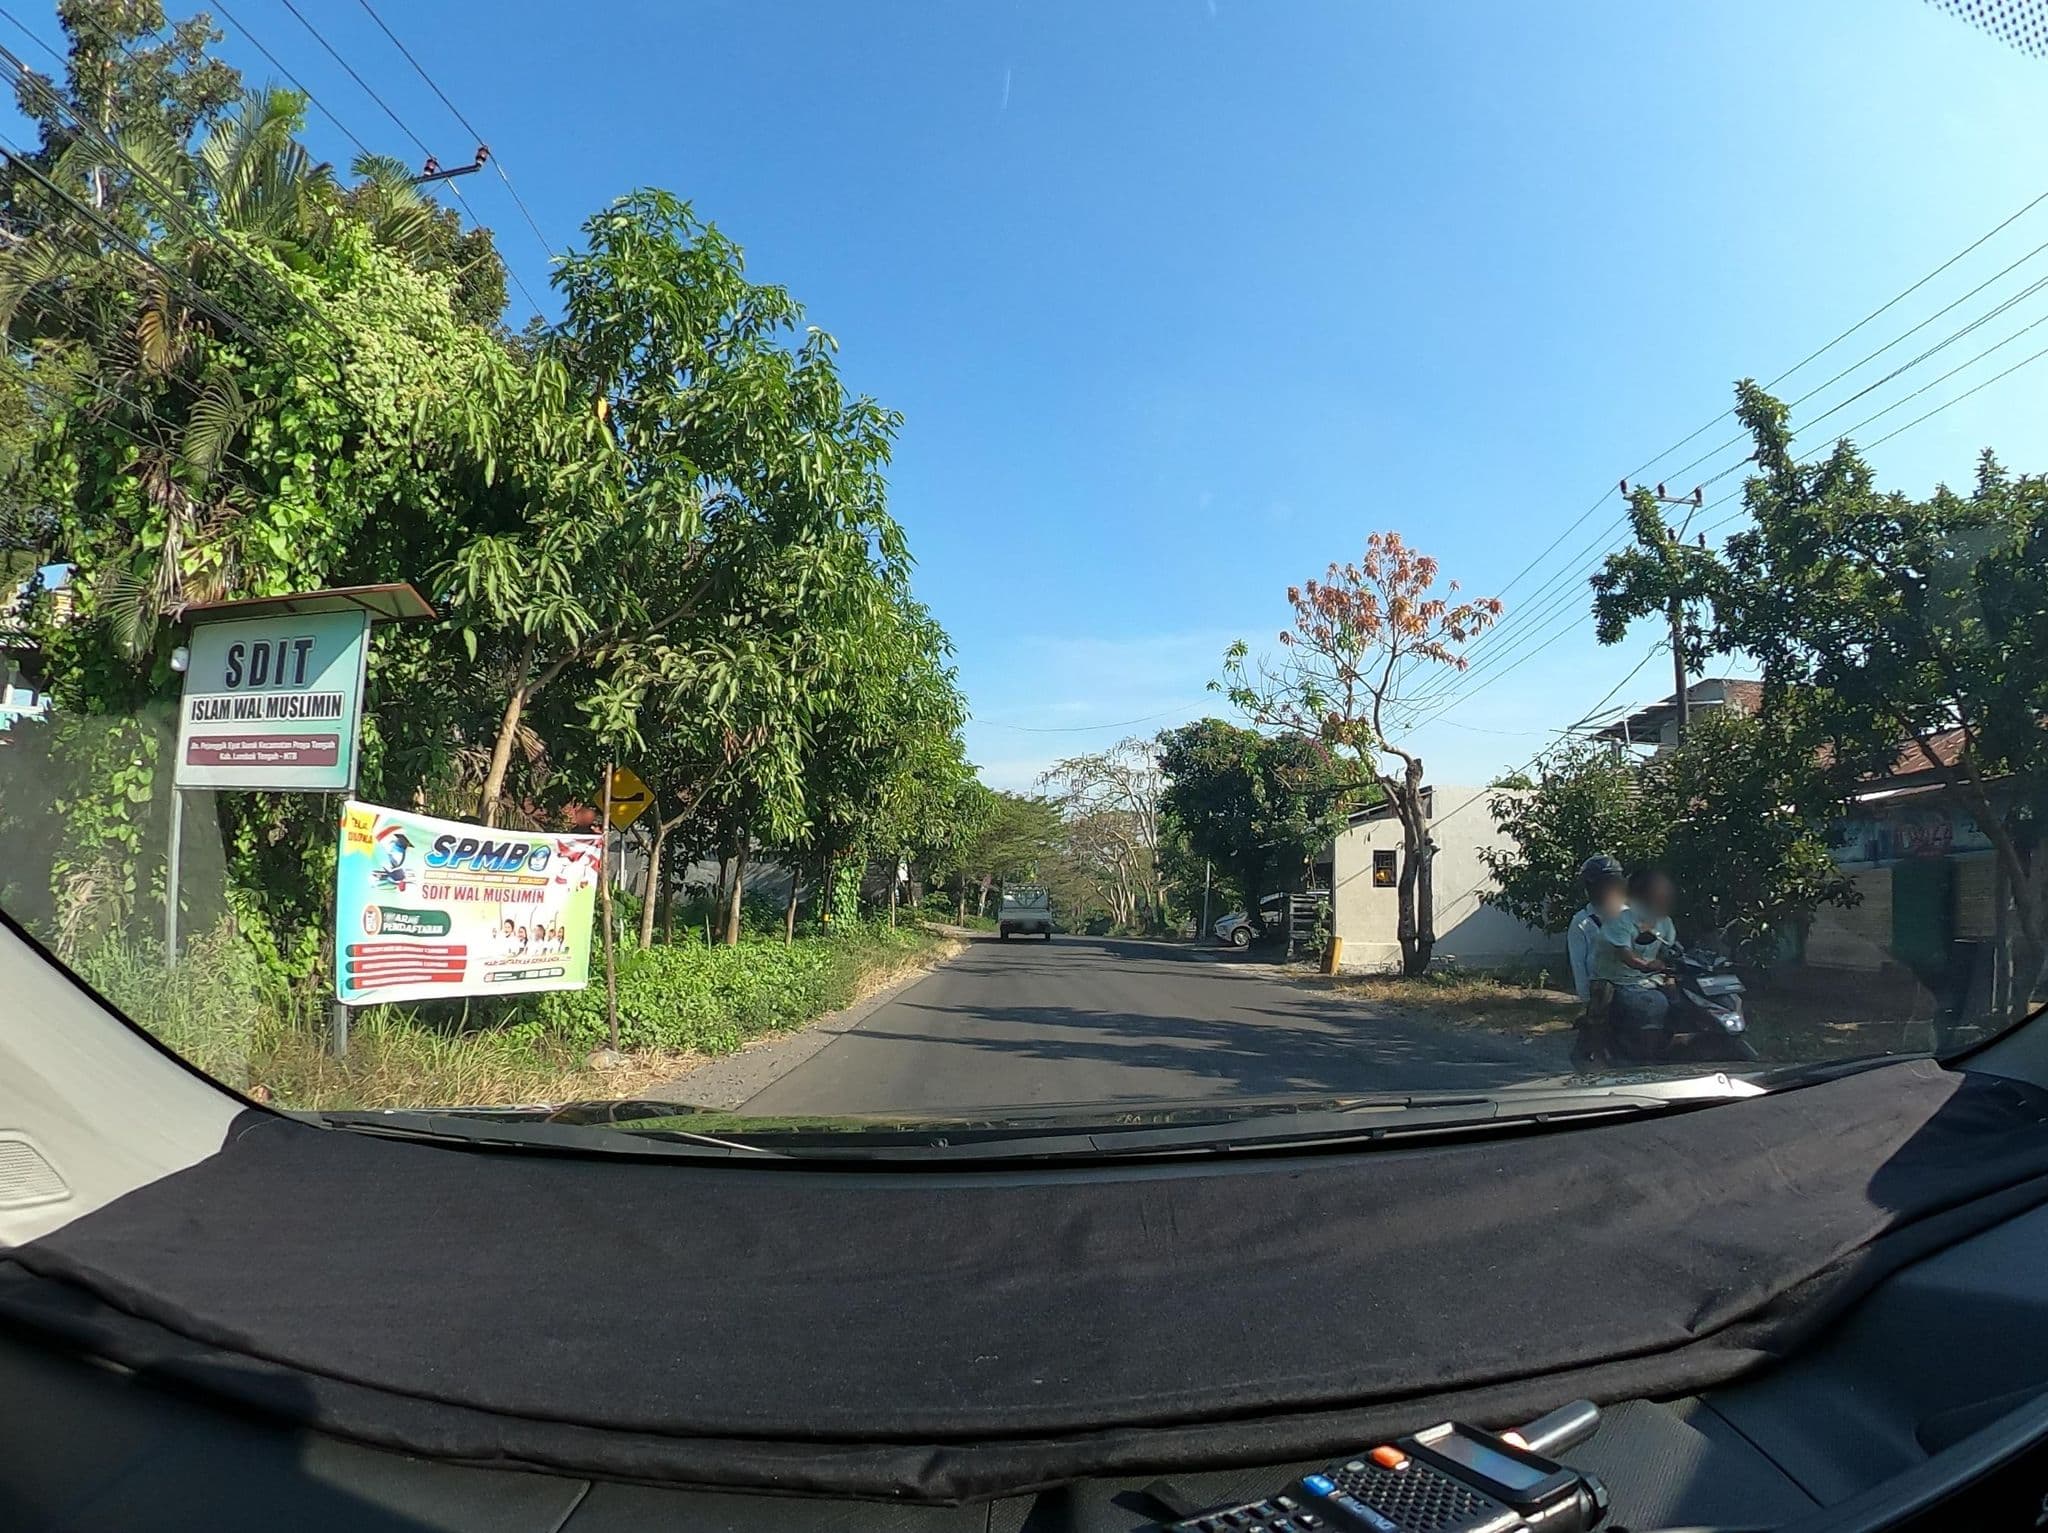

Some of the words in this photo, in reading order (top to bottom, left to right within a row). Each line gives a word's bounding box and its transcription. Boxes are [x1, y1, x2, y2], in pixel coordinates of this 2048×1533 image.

[226, 638, 314, 689] SDIT
[191, 699, 230, 721] ISLAM
[234, 697, 262, 720] WAL
[266, 694, 343, 719] MUSLIMIN
[425, 834, 530, 872] SPMB
[454, 886, 479, 902] WAL
[483, 888, 545, 904] MUSLIMIN
